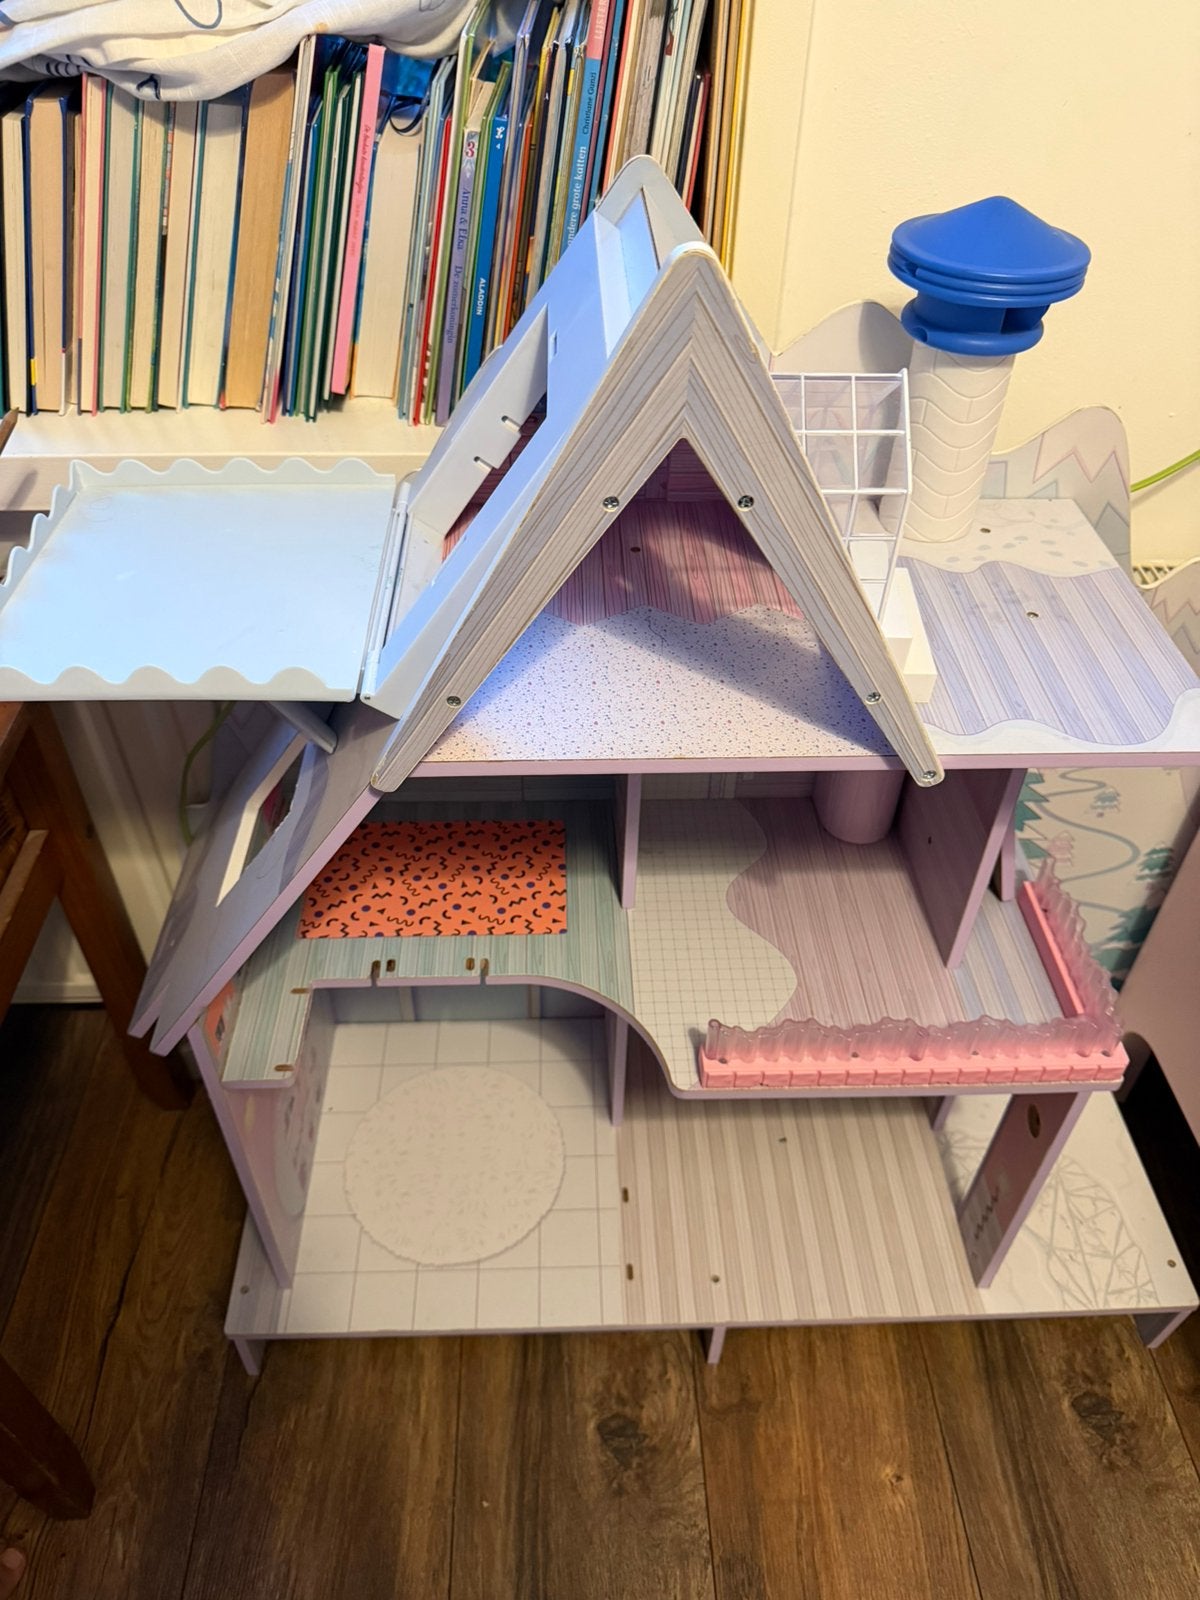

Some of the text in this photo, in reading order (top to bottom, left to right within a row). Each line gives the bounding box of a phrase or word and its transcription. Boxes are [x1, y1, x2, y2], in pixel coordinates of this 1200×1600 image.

[582, 72, 597, 135] Christiane Gunzi
[466, 141, 475, 158] 3
[574, 146, 587, 180] katten
[571, 183, 582, 210] grote
[456, 190, 471, 251] Anna & Elsa
[446, 265, 463, 344] De zomerkoningin
[476, 277, 487, 316] ALADDIN
